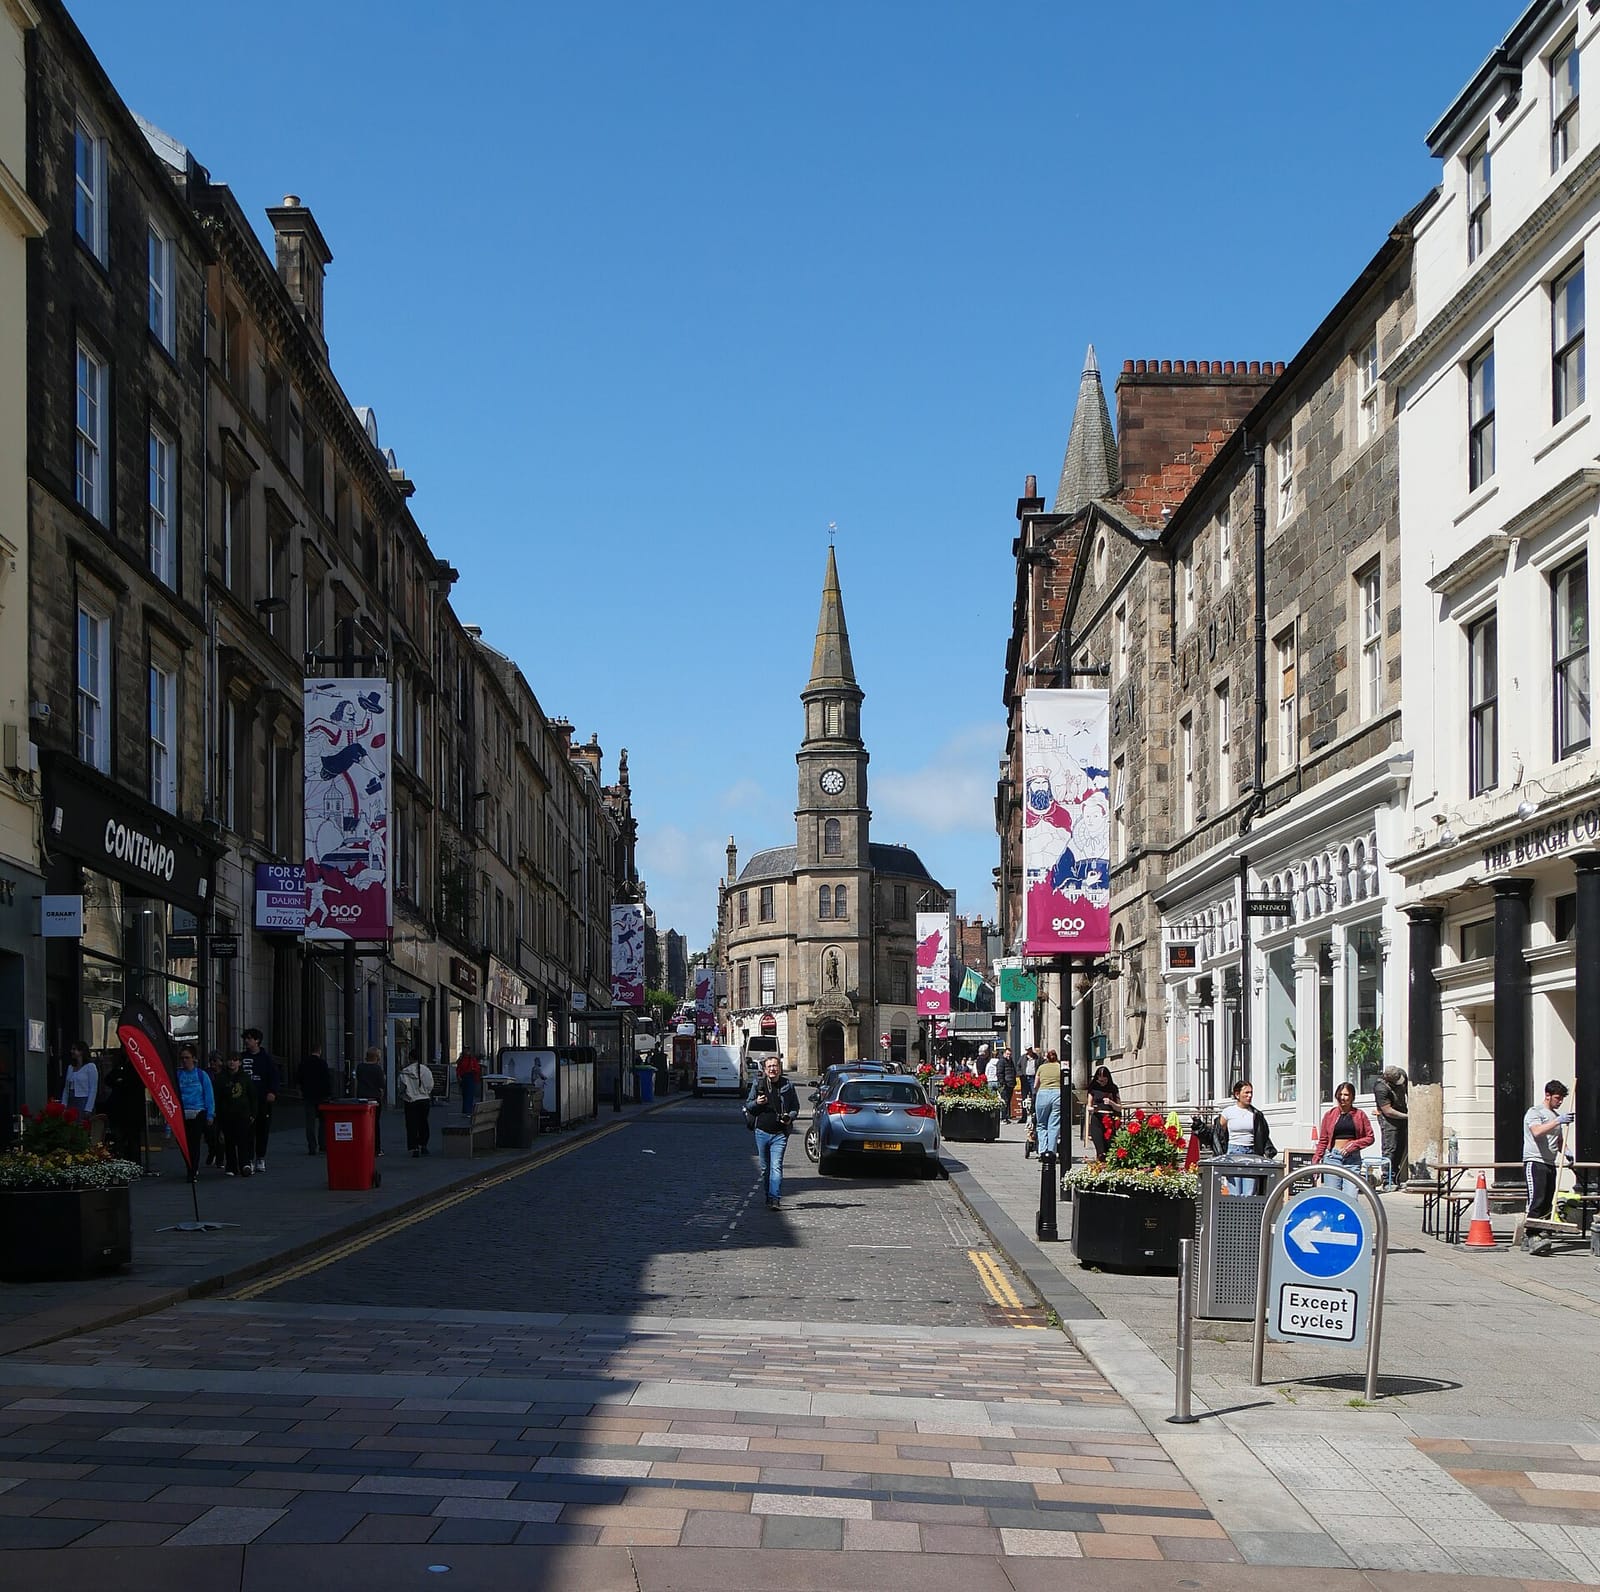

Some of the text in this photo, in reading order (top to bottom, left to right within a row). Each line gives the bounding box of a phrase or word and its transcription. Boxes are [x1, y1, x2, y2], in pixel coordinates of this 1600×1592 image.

[1482, 808, 1600, 871] THE BURGH CO
[104, 818, 175, 881] CONTEMPO
[268, 866, 291, 878] FOR
[278, 879, 295, 891] TO
[271, 896, 301, 905] DALKIN
[330, 904, 362, 917] 900
[266, 915, 293, 925] 07766
[1052, 917, 1085, 931] 900
[1290, 1293, 1348, 1313] Except
[1291, 1314, 1343, 1330] cycles
